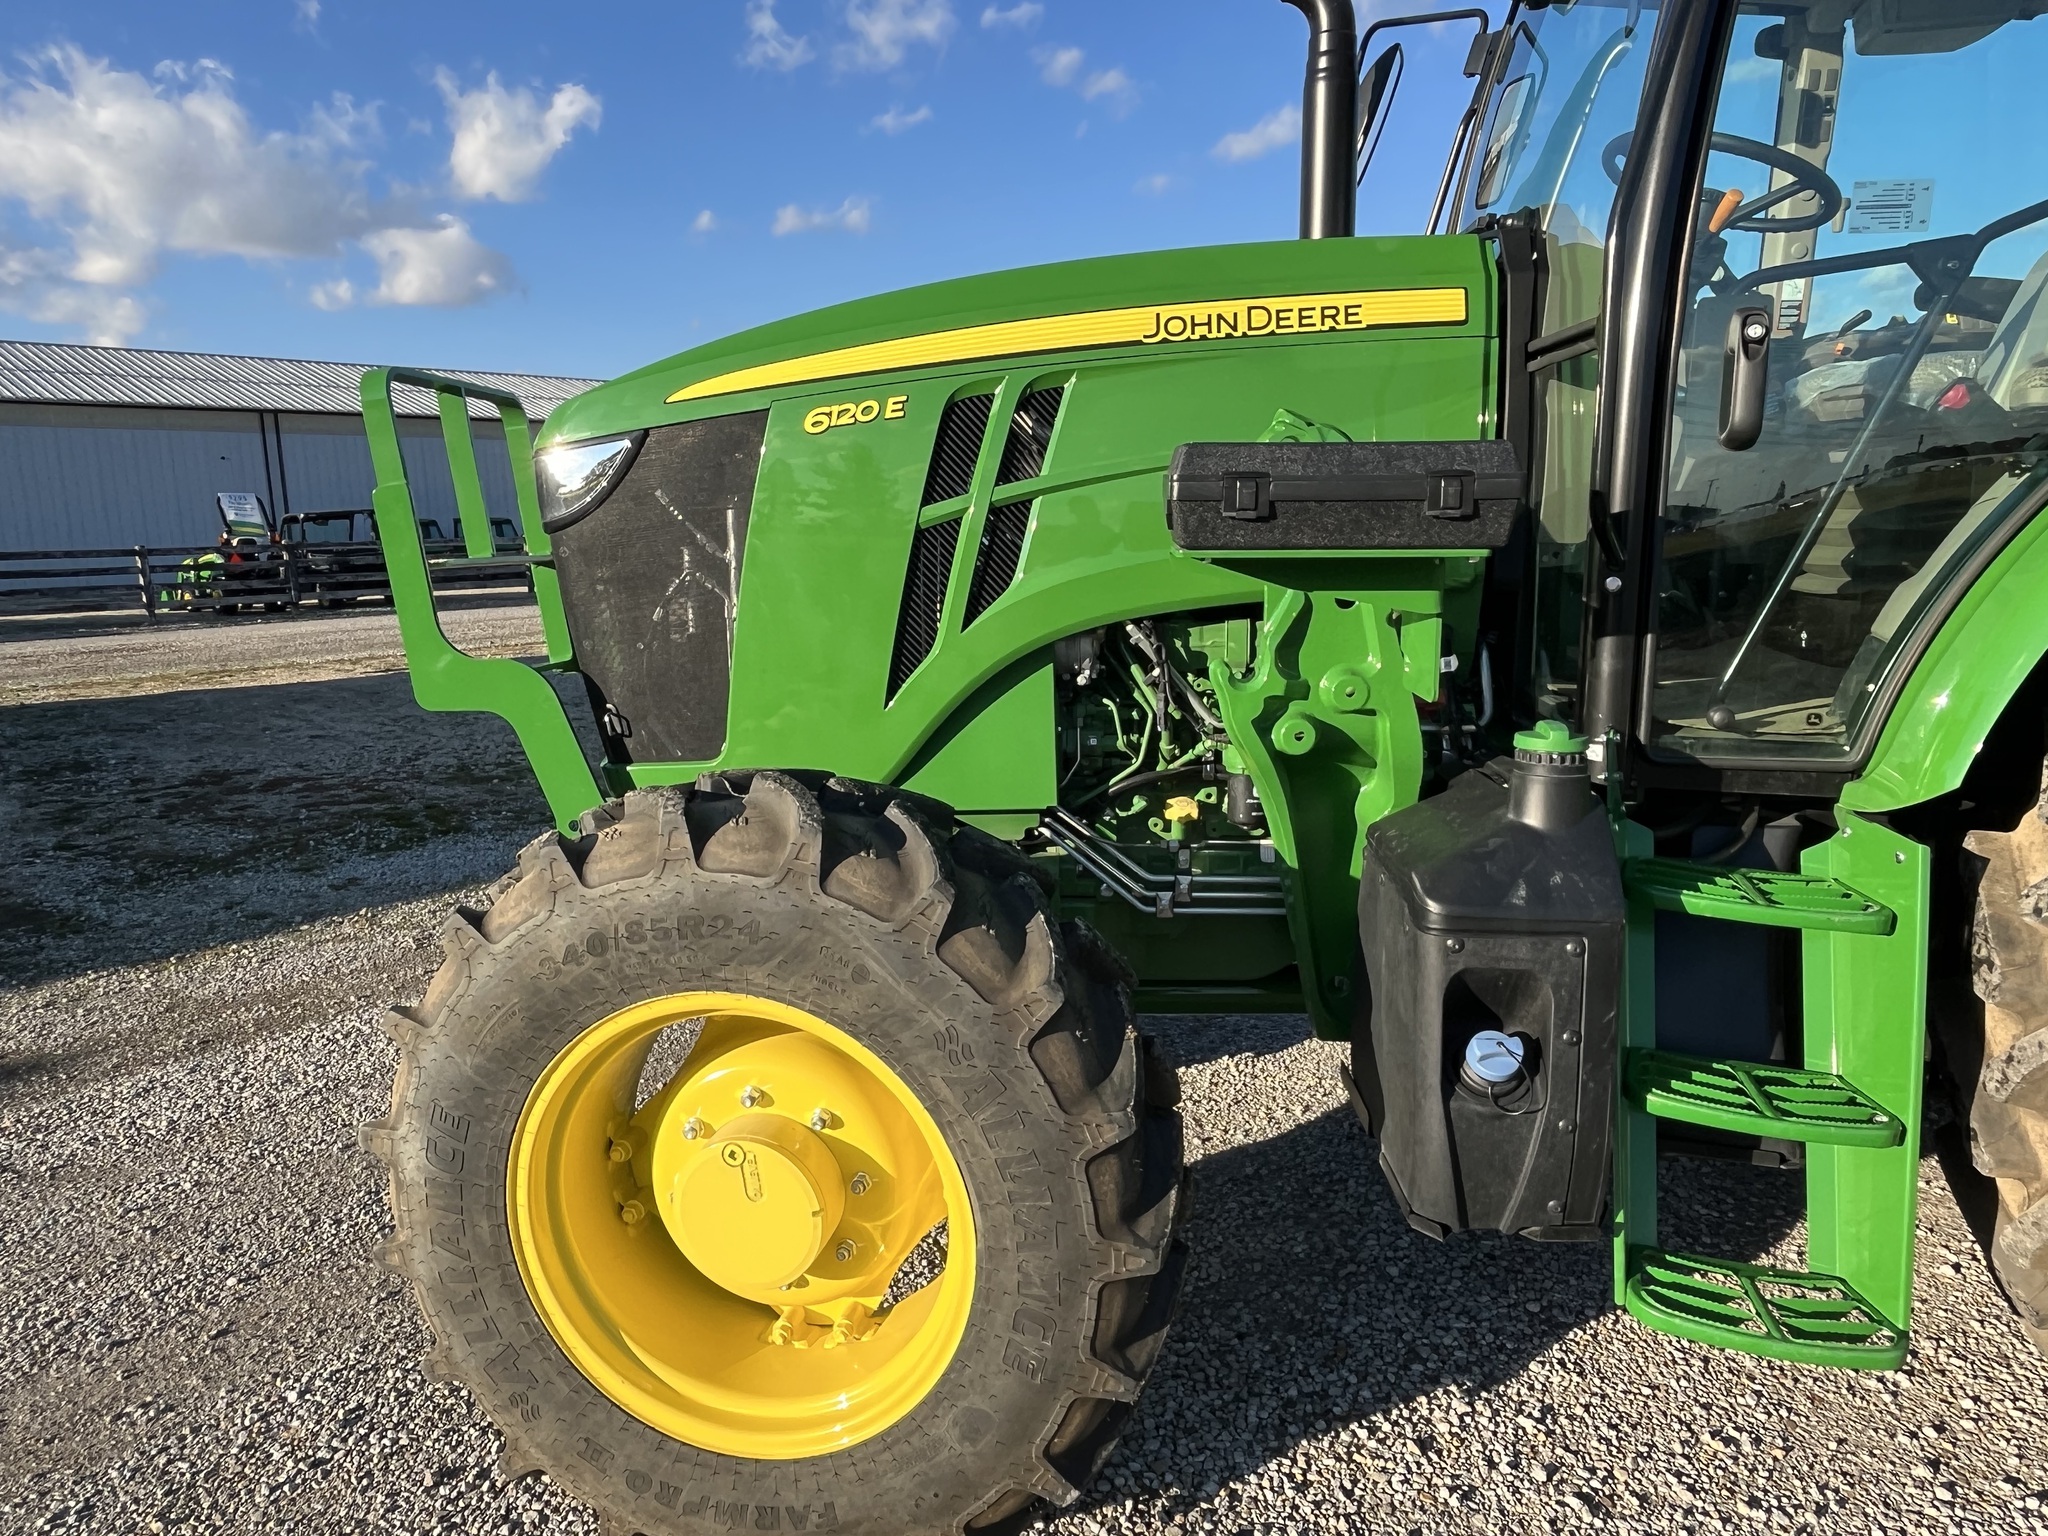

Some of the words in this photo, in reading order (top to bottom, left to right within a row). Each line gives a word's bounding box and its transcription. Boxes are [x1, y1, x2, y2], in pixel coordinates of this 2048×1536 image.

[1142, 311, 1239, 339] JOHN
[1246, 304, 1363, 332] DEERE
[803, 399, 881, 435] 6120
[884, 395, 909, 421] E
[538, 913, 762, 982] 340/85R24
[423, 1103, 540, 1386] ALLIANCE
[940, 1068, 1062, 1386] ALLIANCE
[624, 1468, 840, 1531] FARMPRO
